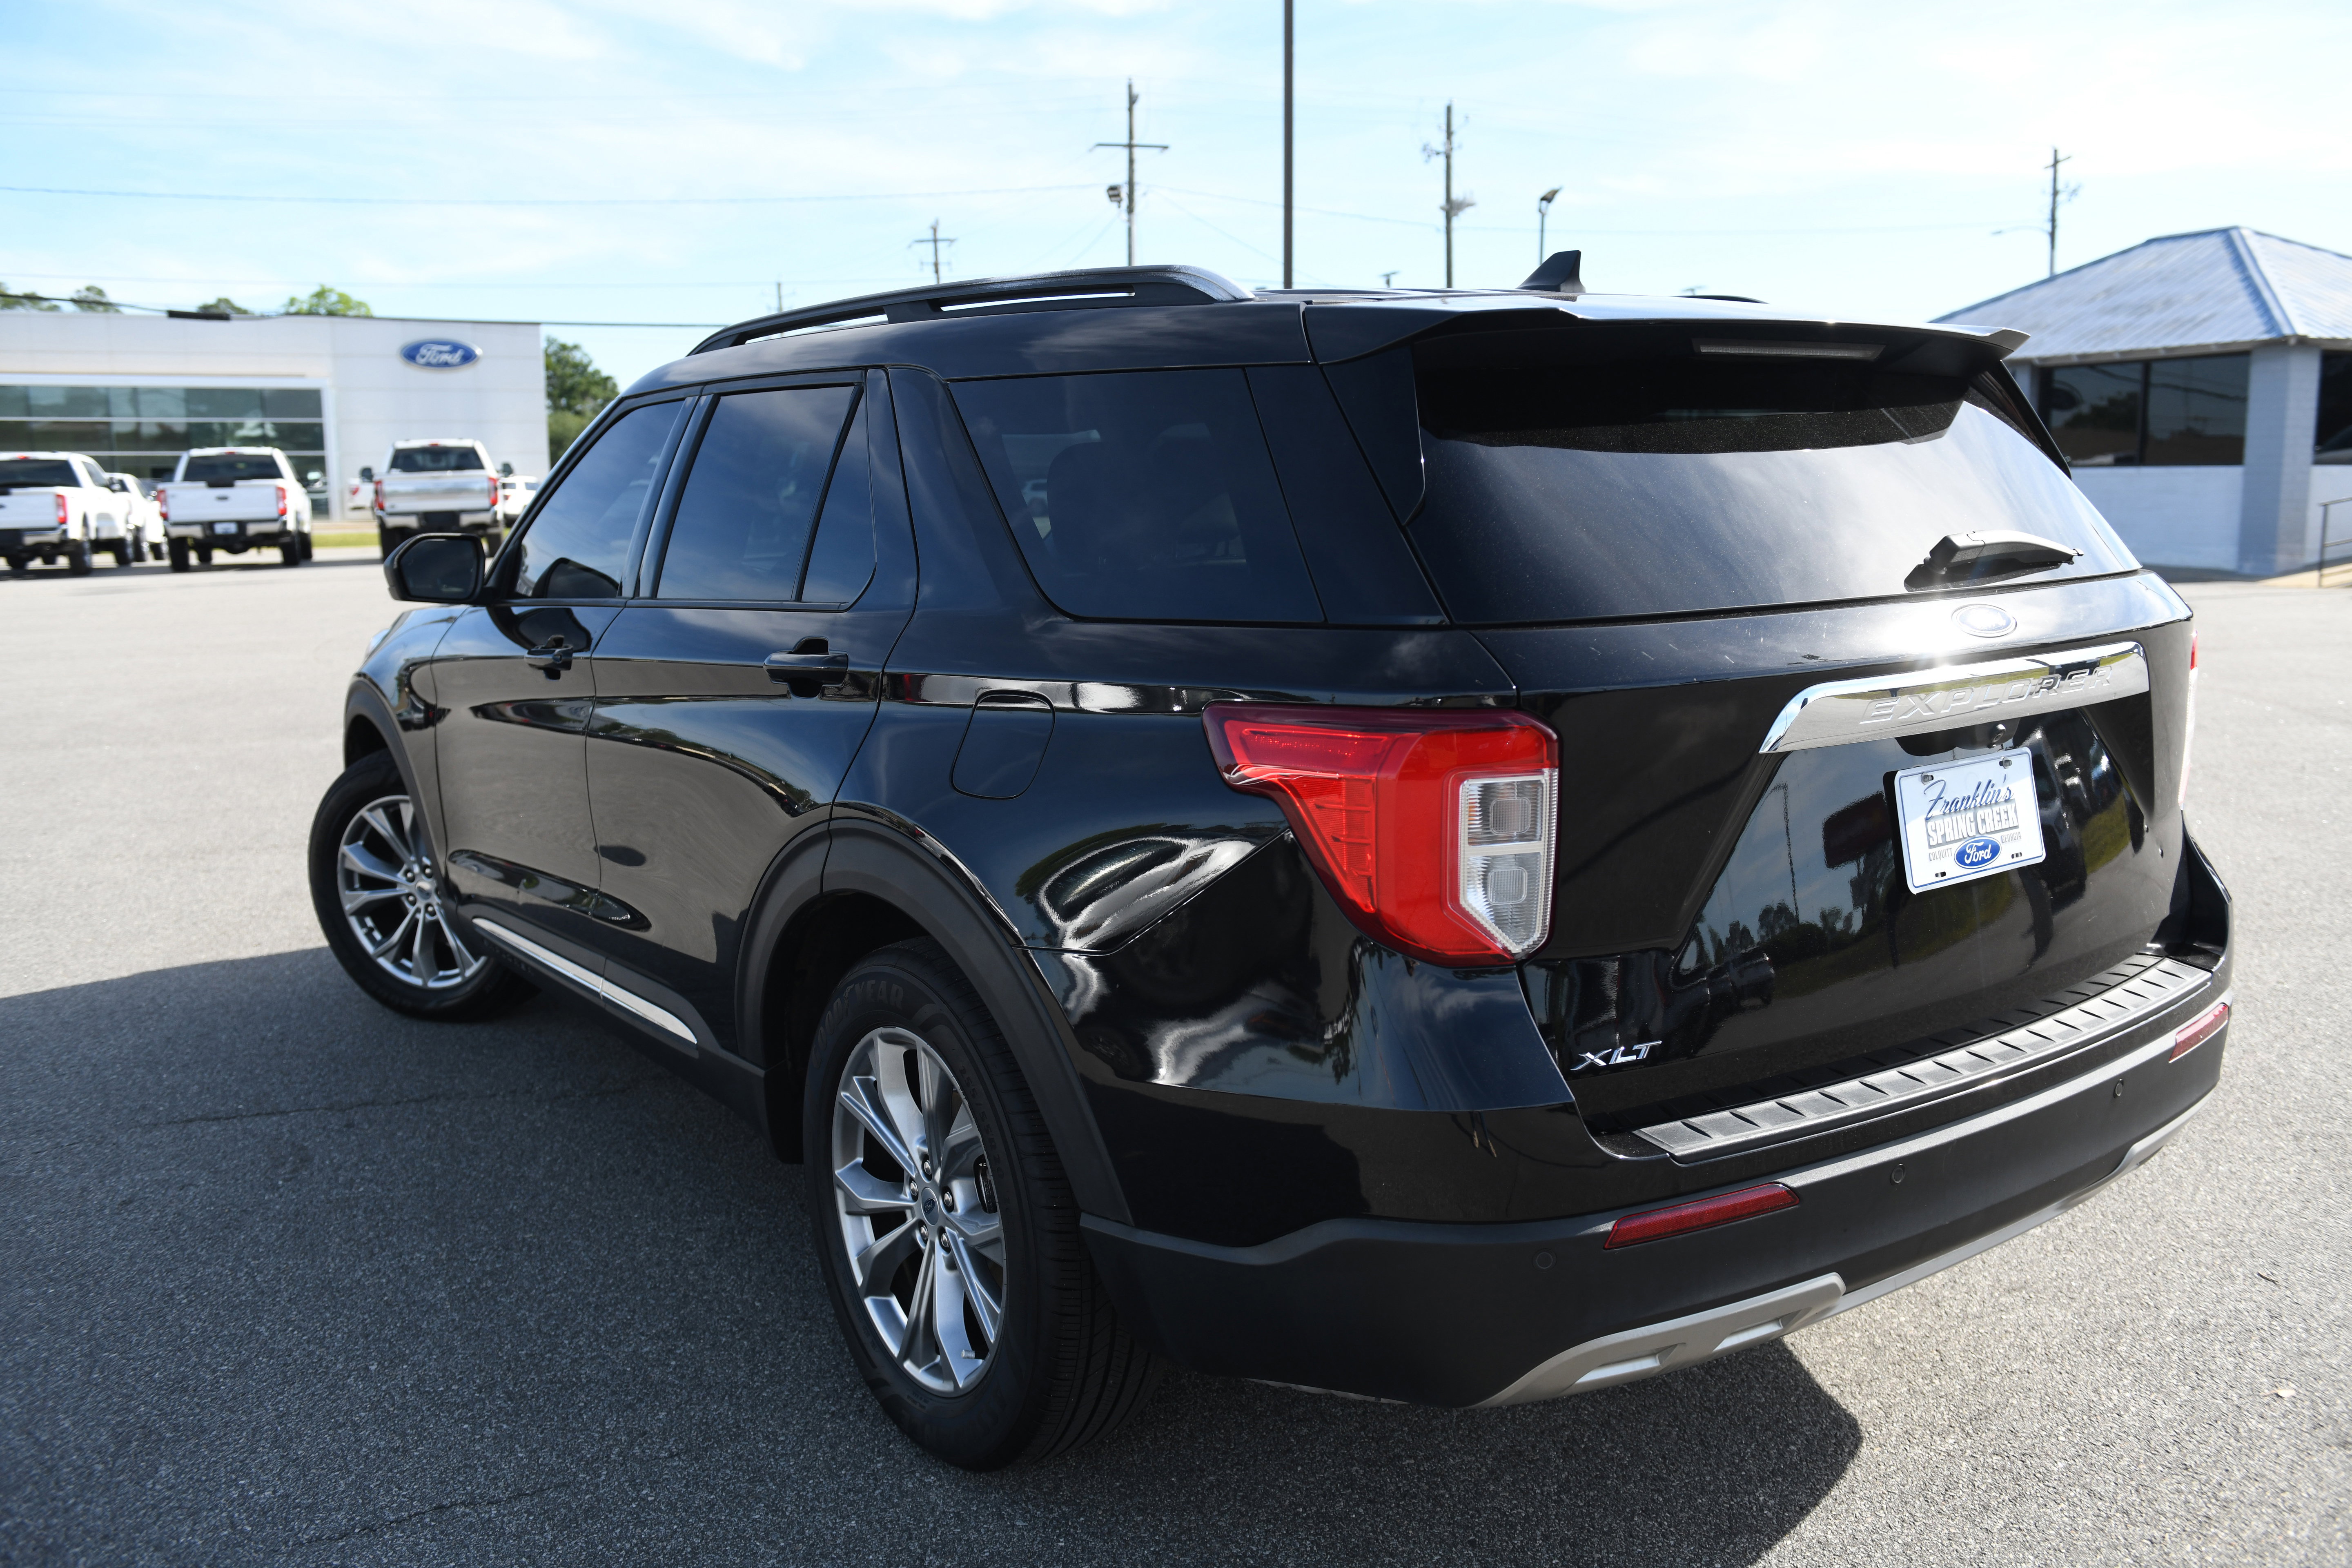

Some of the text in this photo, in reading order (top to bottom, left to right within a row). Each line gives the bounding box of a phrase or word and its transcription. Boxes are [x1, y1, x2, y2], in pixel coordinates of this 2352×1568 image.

[416, 343, 465, 365] Ford
[1859, 665, 2113, 724] EXPLORER
[1923, 774, 2014, 821] Franklin's
[1927, 804, 2018, 846] SPRING CREEK
[2001, 831, 2022, 844] GEORGIA
[1929, 847, 1953, 862] COLQUITT
[1964, 841, 1992, 864] Ford
[1570, 1040, 1662, 1071] XLT
